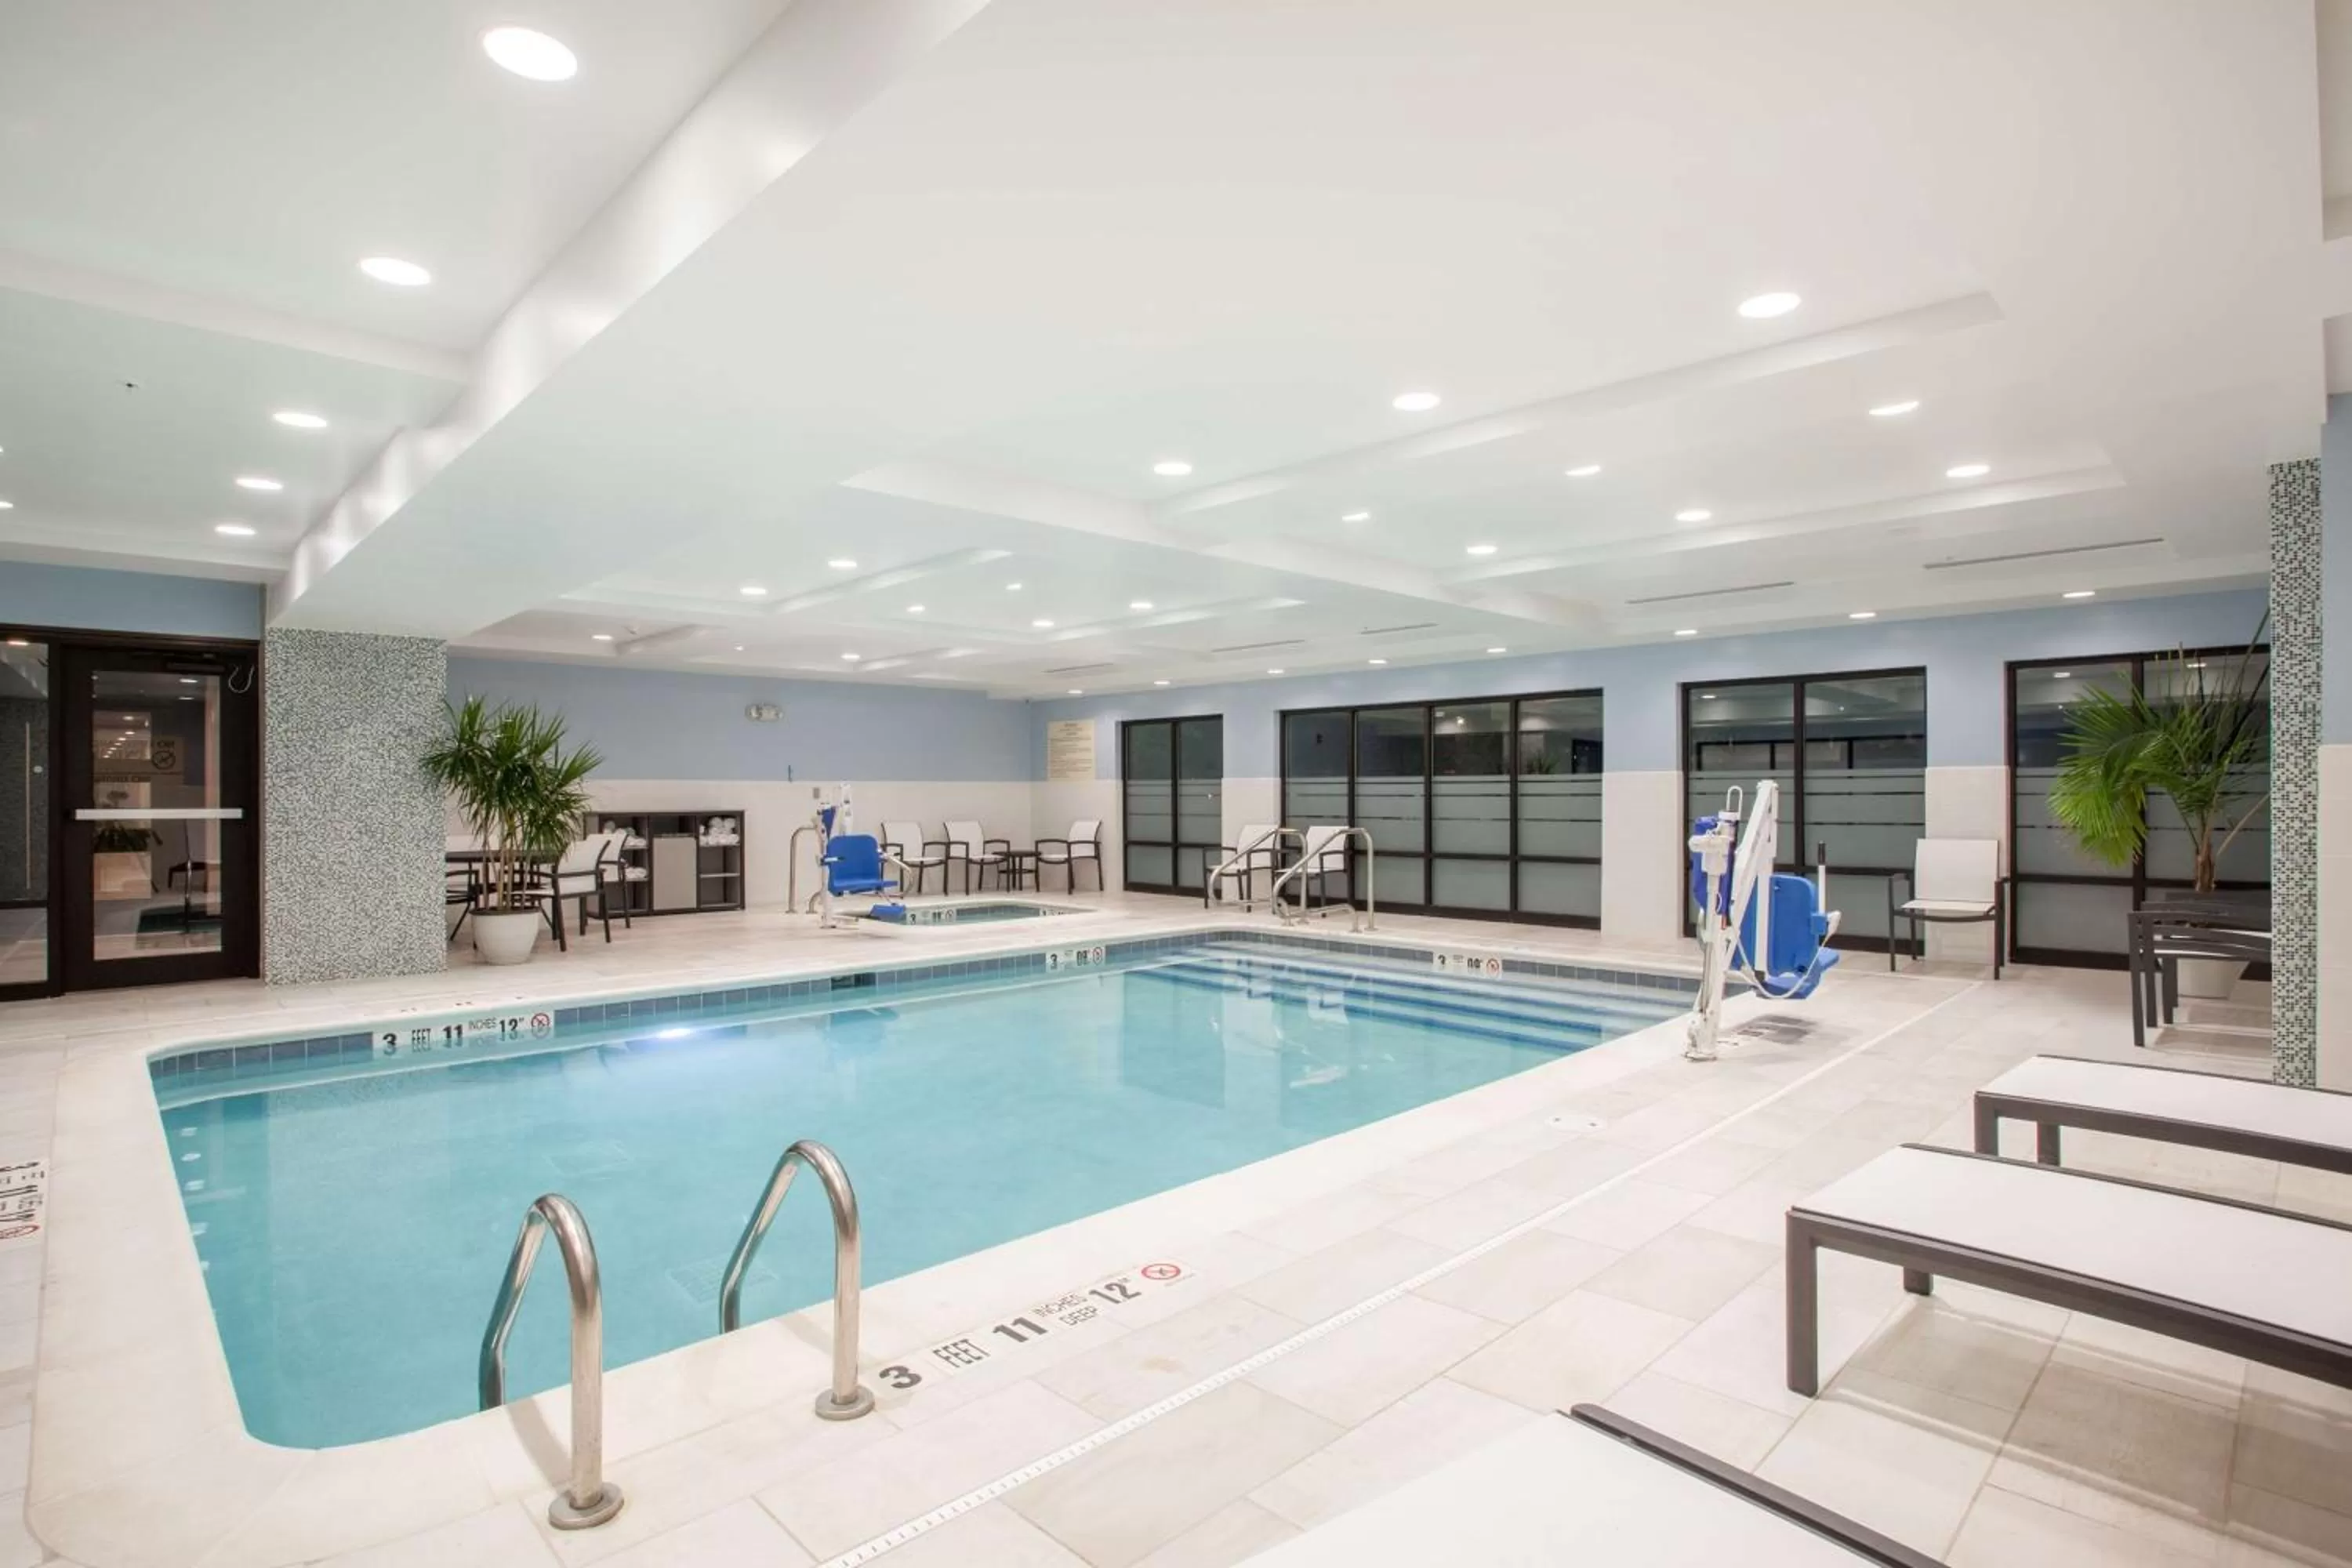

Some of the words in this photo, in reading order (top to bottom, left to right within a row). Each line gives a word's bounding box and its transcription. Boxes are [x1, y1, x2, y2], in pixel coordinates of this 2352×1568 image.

[879, 1365, 922, 1388] 3
[932, 1338, 991, 1368] FEET
[992, 1316, 1048, 1343] 11
[1033, 1293, 1088, 1318] INCHES
[1058, 1305, 1098, 1326] DEEP
